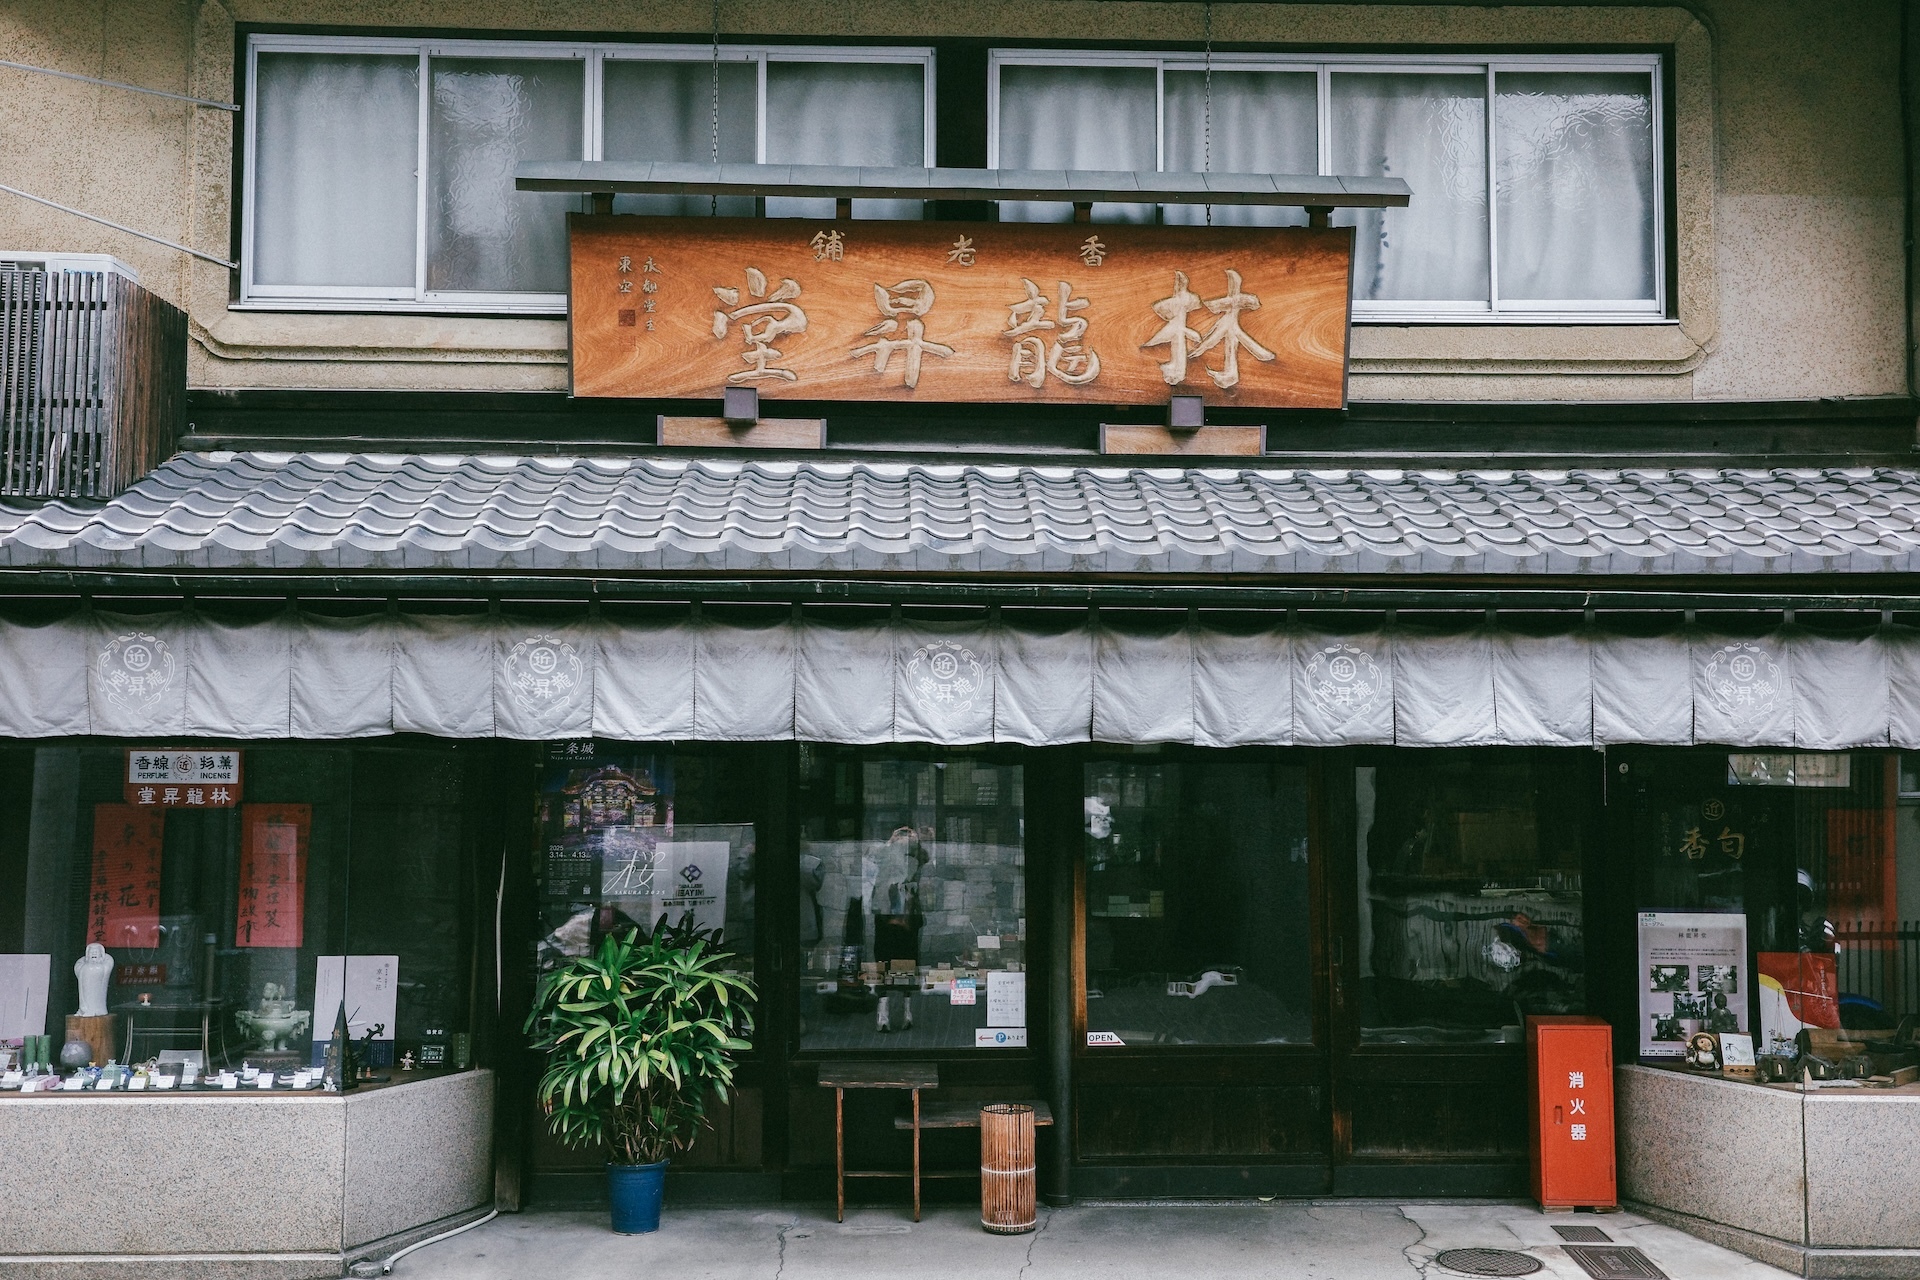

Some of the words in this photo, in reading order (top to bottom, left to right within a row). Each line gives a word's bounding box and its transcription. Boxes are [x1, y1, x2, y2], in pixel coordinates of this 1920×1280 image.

[126, 647, 149, 669] 近
[532, 650, 554, 671] 近
[933, 655, 956, 676] 近
[1733, 658, 1754, 678] 近
[1332, 659, 1354, 679] 近
[551, 742, 594, 755] 二条城
[1088, 1034, 1113, 1042] OPEN
[1568, 1071, 1587, 1141] 消火器
